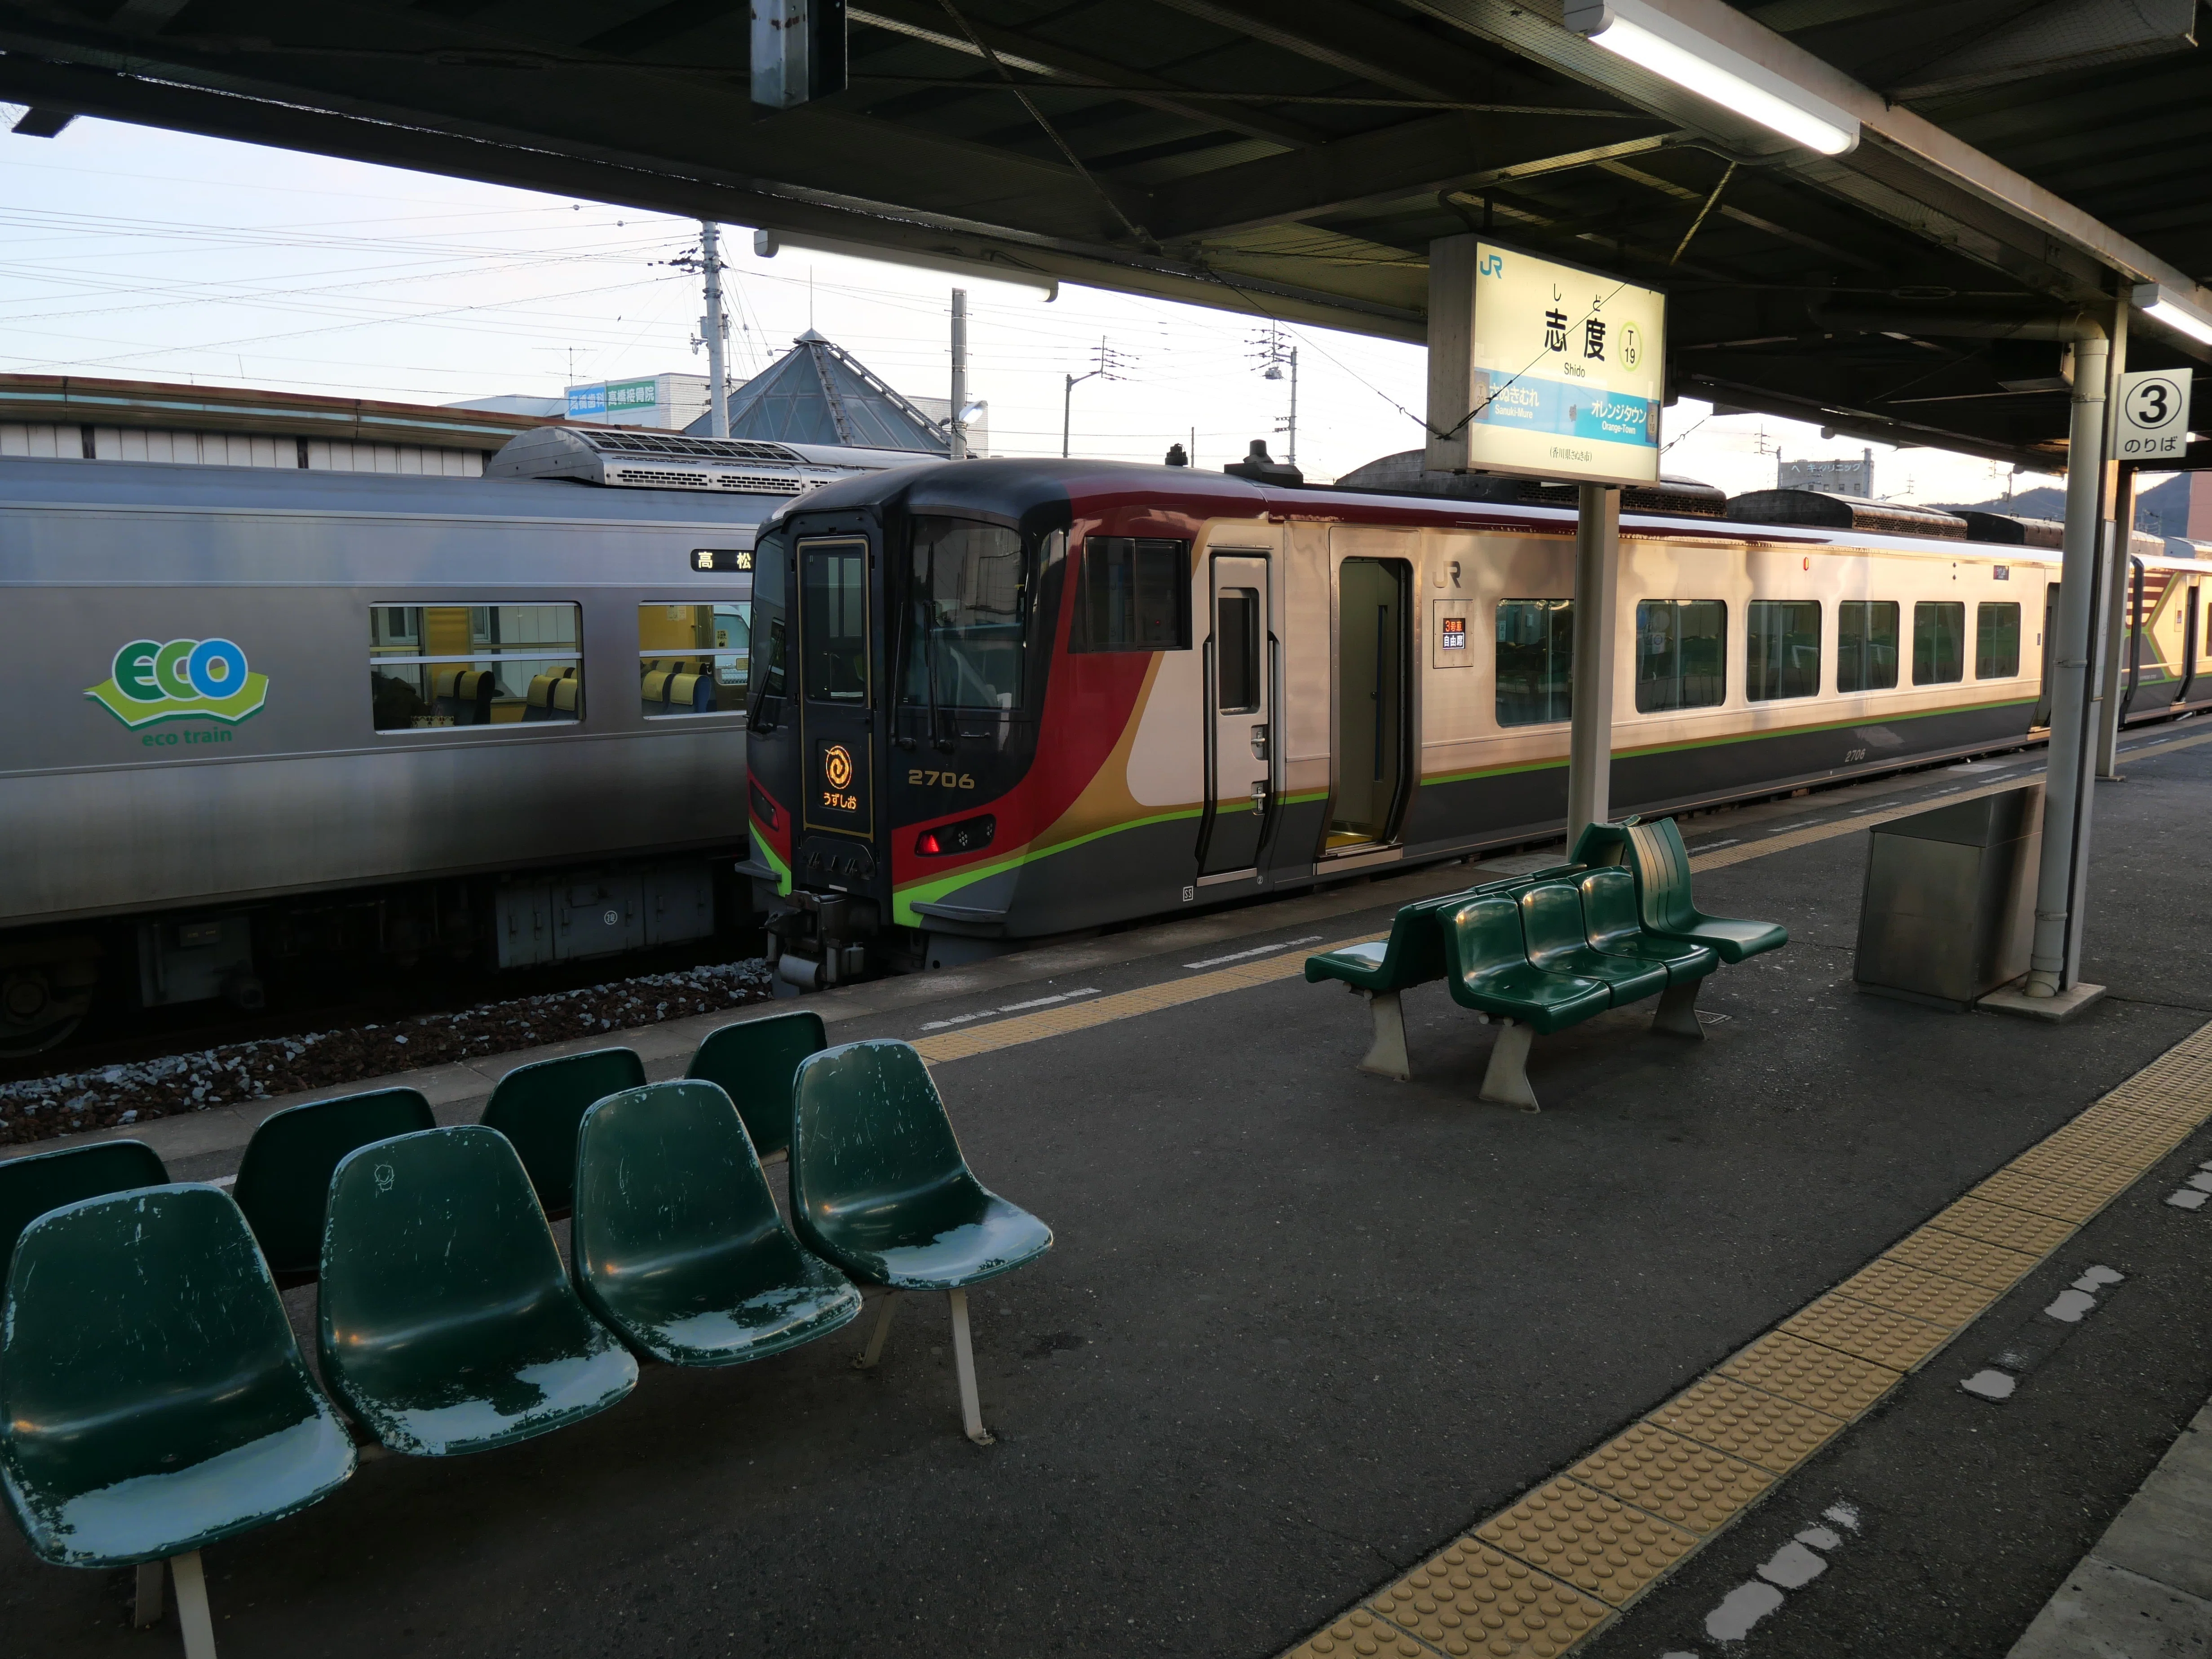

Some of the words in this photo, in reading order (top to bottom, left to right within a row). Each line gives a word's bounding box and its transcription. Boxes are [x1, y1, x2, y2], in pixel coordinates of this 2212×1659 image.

[1480, 254, 1502, 279] JR
[1553, 283, 1601, 312] しど
[1544, 308, 1606, 361] 志度
[1627, 330, 1634, 345] T
[1624, 347, 1636, 364] 19
[1564, 362, 1585, 378] Shido
[570, 392, 604, 410] 高橋歯科
[608, 386, 655, 406] 高橋接骨院
[1489, 383, 1539, 407] さぬきむれ
[1495, 404, 1533, 419] Sanuki-Mure
[1592, 400, 1647, 424] オレンジタウン
[1602, 420, 1636, 434] Orange-Town
[2124, 436, 2178, 453] のりば
[698, 552, 751, 569] 高松
[1432, 561, 1461, 588] JR
[1445, 620, 1462, 632] 3号車
[1443, 635, 1463, 647] 自由席
[142, 732, 179, 747] eco
[183, 726, 232, 744] train
[1845, 748, 1866, 762] 2706
[908, 769, 975, 789] 2706
[823, 792, 857, 810] うずしお
[1185, 889, 1192, 898] SS
